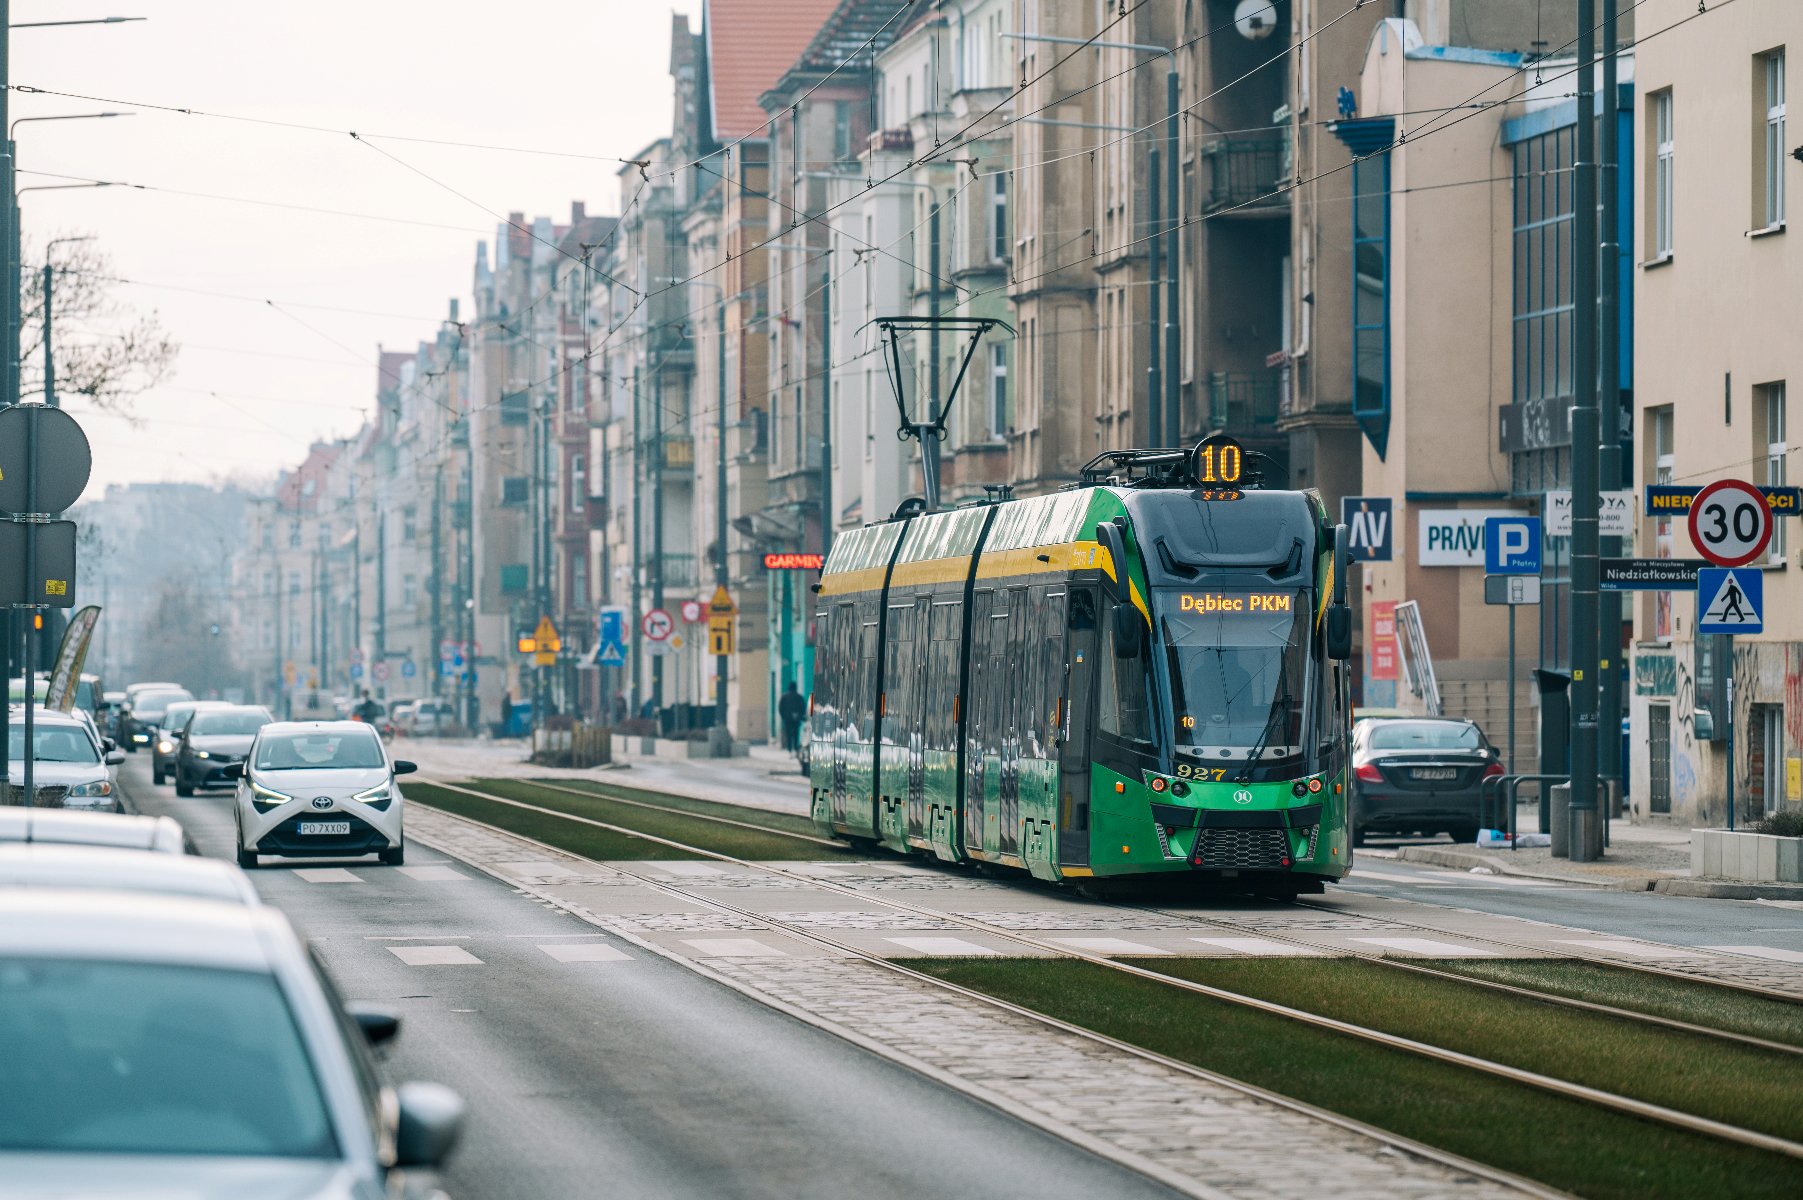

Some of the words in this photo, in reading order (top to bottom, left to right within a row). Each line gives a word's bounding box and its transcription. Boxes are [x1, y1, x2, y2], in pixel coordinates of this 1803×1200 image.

[1201, 445, 1240, 482] 10
[1703, 503, 1759, 544] 30
[1499, 523, 1529, 567] P
[1512, 559, 1537, 568] Płatny
[1607, 569, 1697, 580] Niedziałkowskie
[1181, 595, 1242, 614] Dębiec
[1249, 595, 1290, 611] PKM
[1181, 716, 1195, 728] 10
[1177, 764, 1227, 782] 927
[302, 823, 316, 833] PO
